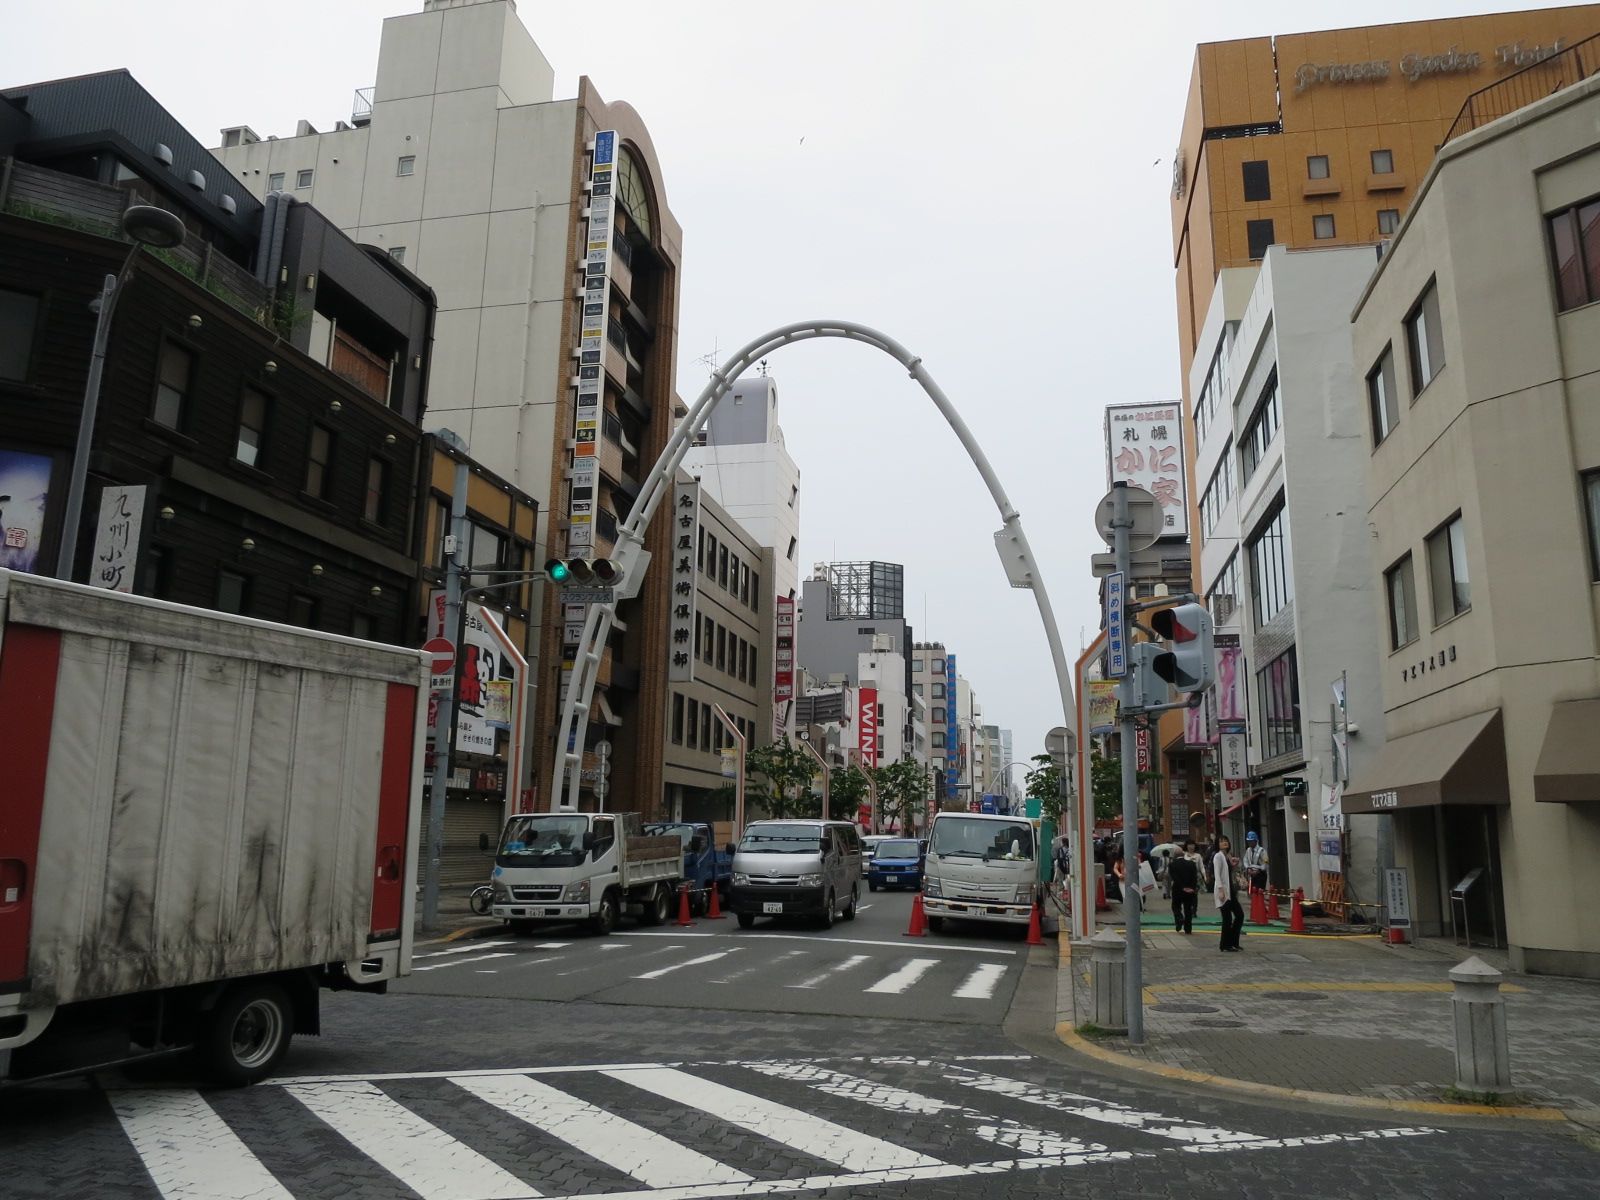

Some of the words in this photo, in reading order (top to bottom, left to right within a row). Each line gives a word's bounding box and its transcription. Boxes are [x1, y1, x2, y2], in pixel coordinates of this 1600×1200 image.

[1294, 58, 1391, 92] Princess
[1399, 46, 1484, 81] Garden
[1122, 424, 1168, 442] 札幌
[1114, 445, 1178, 475] かに
[99, 487, 132, 589] 九州小町
[1109, 582, 1124, 667] 斜め横断専用
